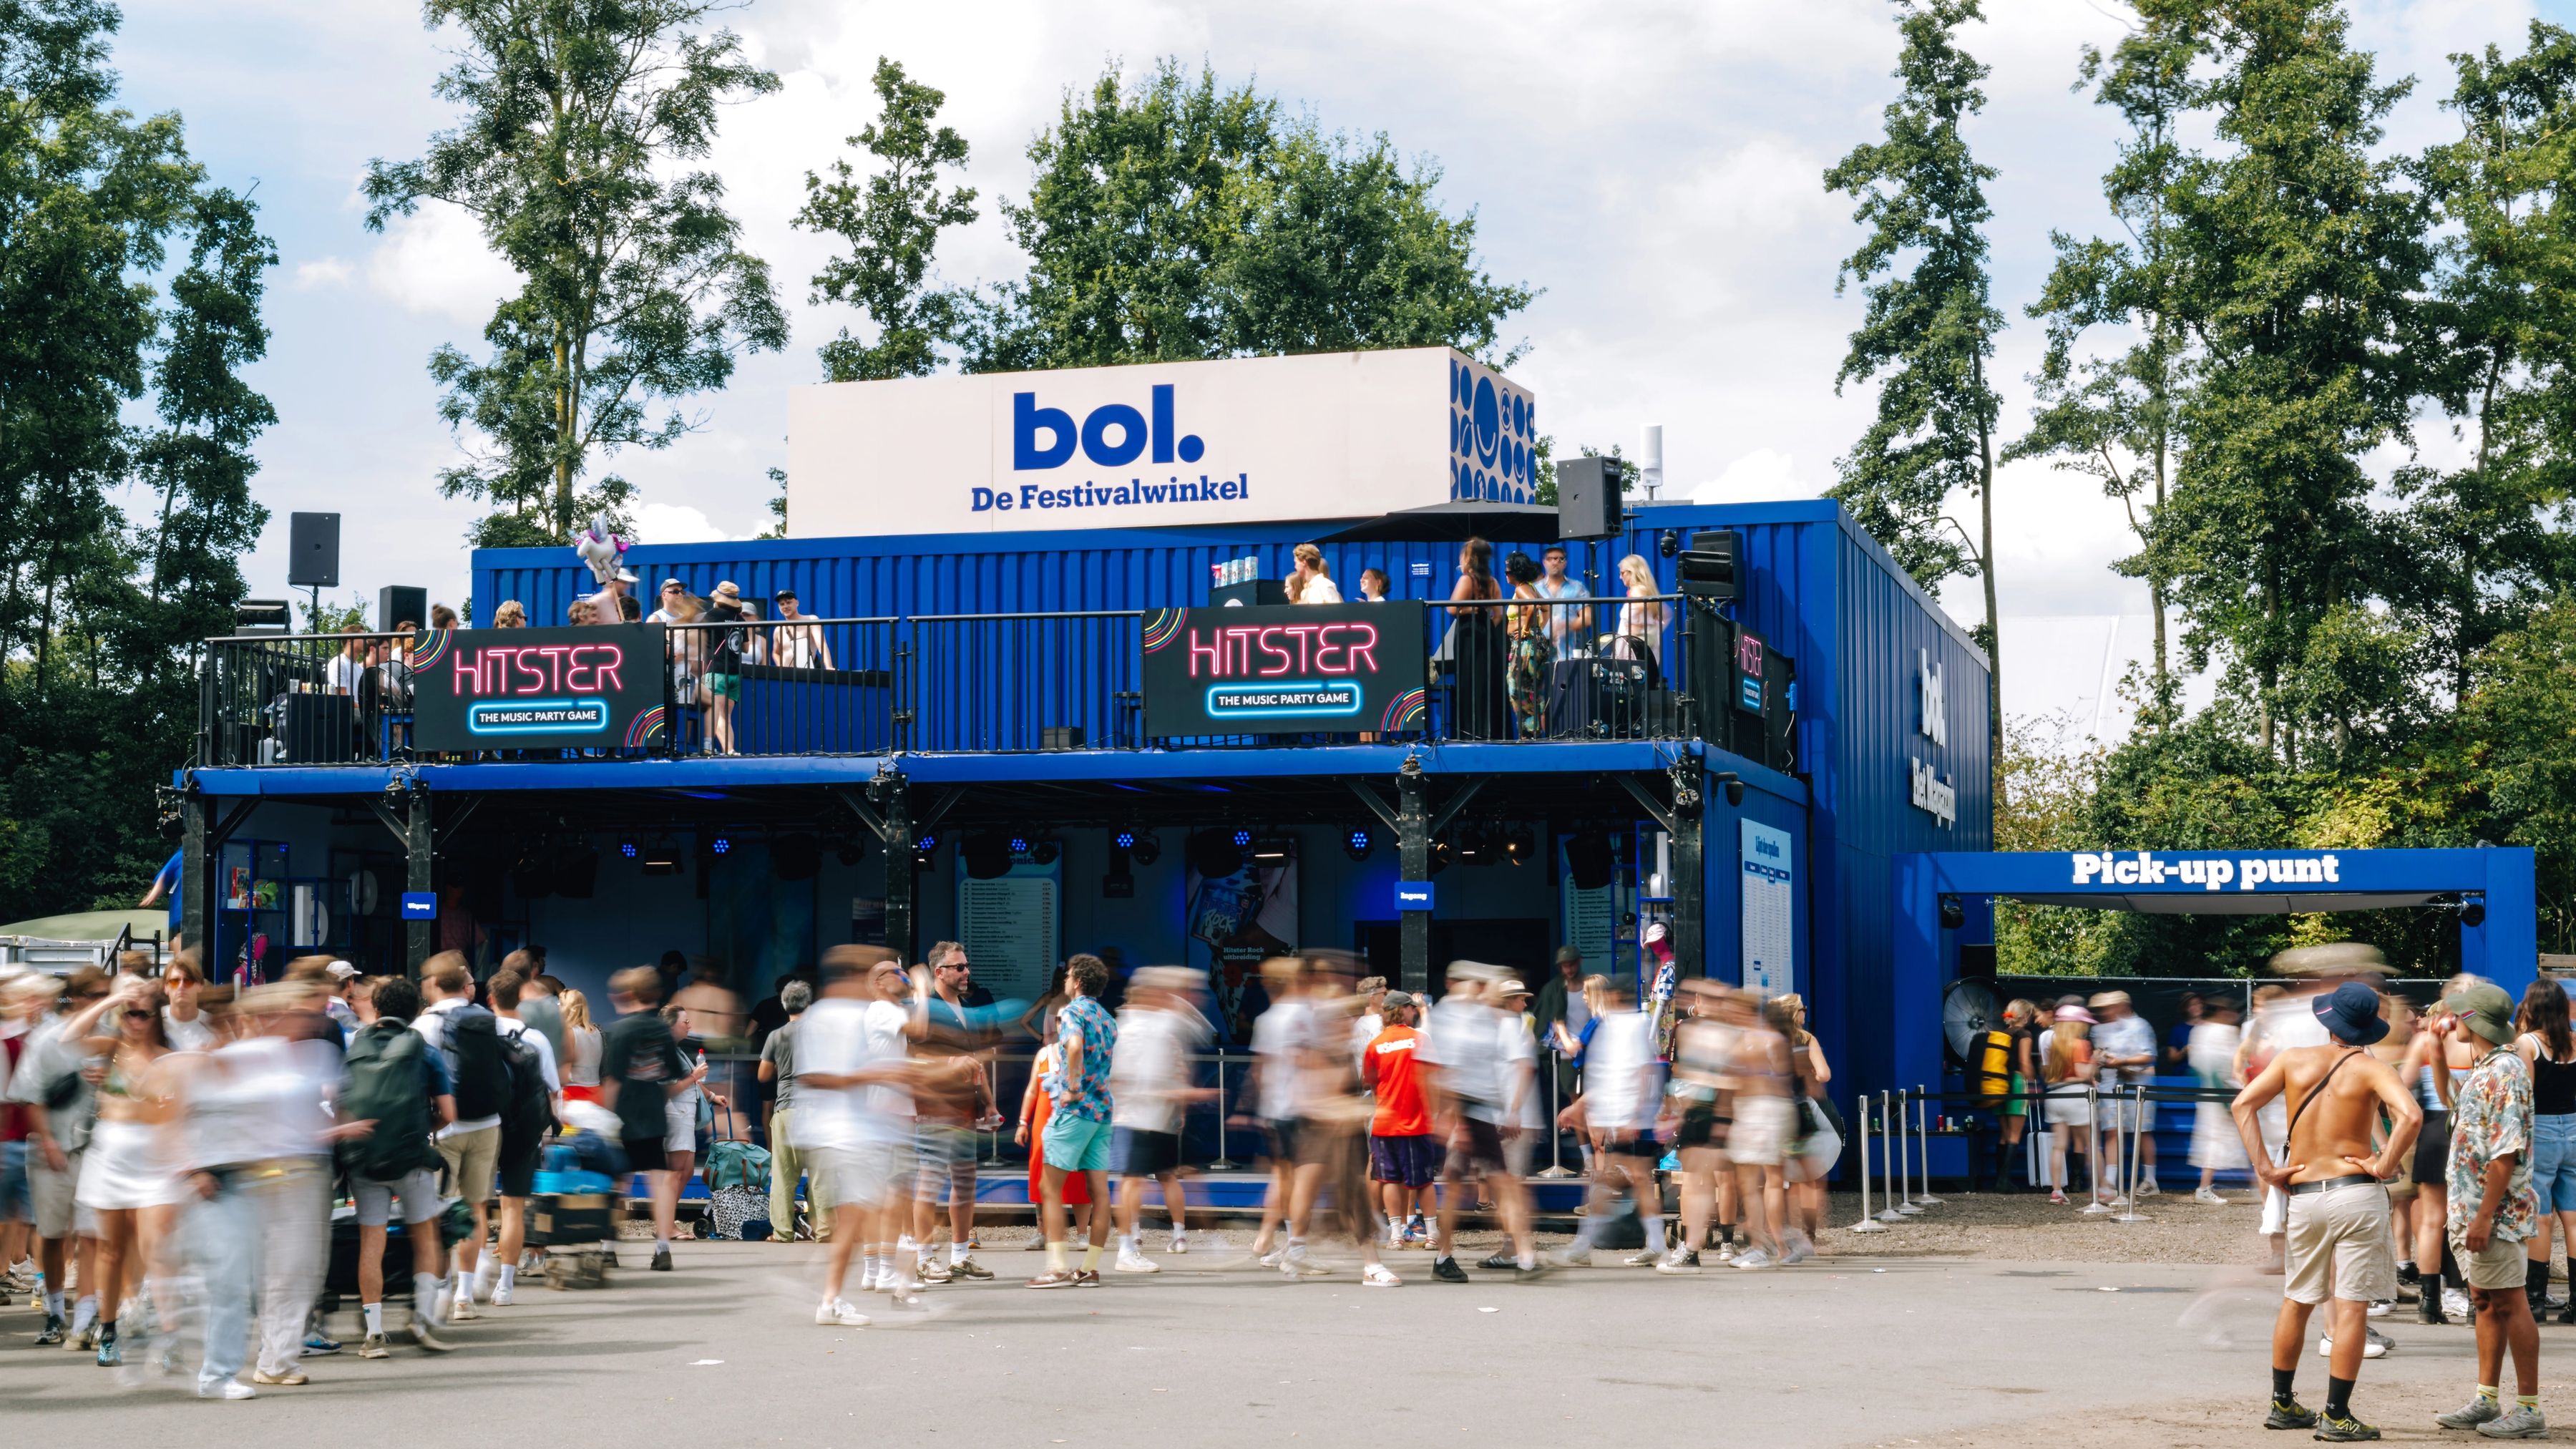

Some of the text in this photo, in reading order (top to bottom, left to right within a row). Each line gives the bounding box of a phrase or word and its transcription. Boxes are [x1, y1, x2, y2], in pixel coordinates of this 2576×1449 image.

[1013, 384, 1205, 470] bol.
[972, 473, 1249, 512] De Festivalwinkel
[1191, 623, 1378, 676] HITSTER
[454, 644, 623, 695] HITSTER
[479, 711, 597, 723] THE MUSIC PARTY GAME
[1219, 693, 1349, 706] THE MUSIC PARTY GAME
[2072, 852, 2339, 890] Pick-up punt
